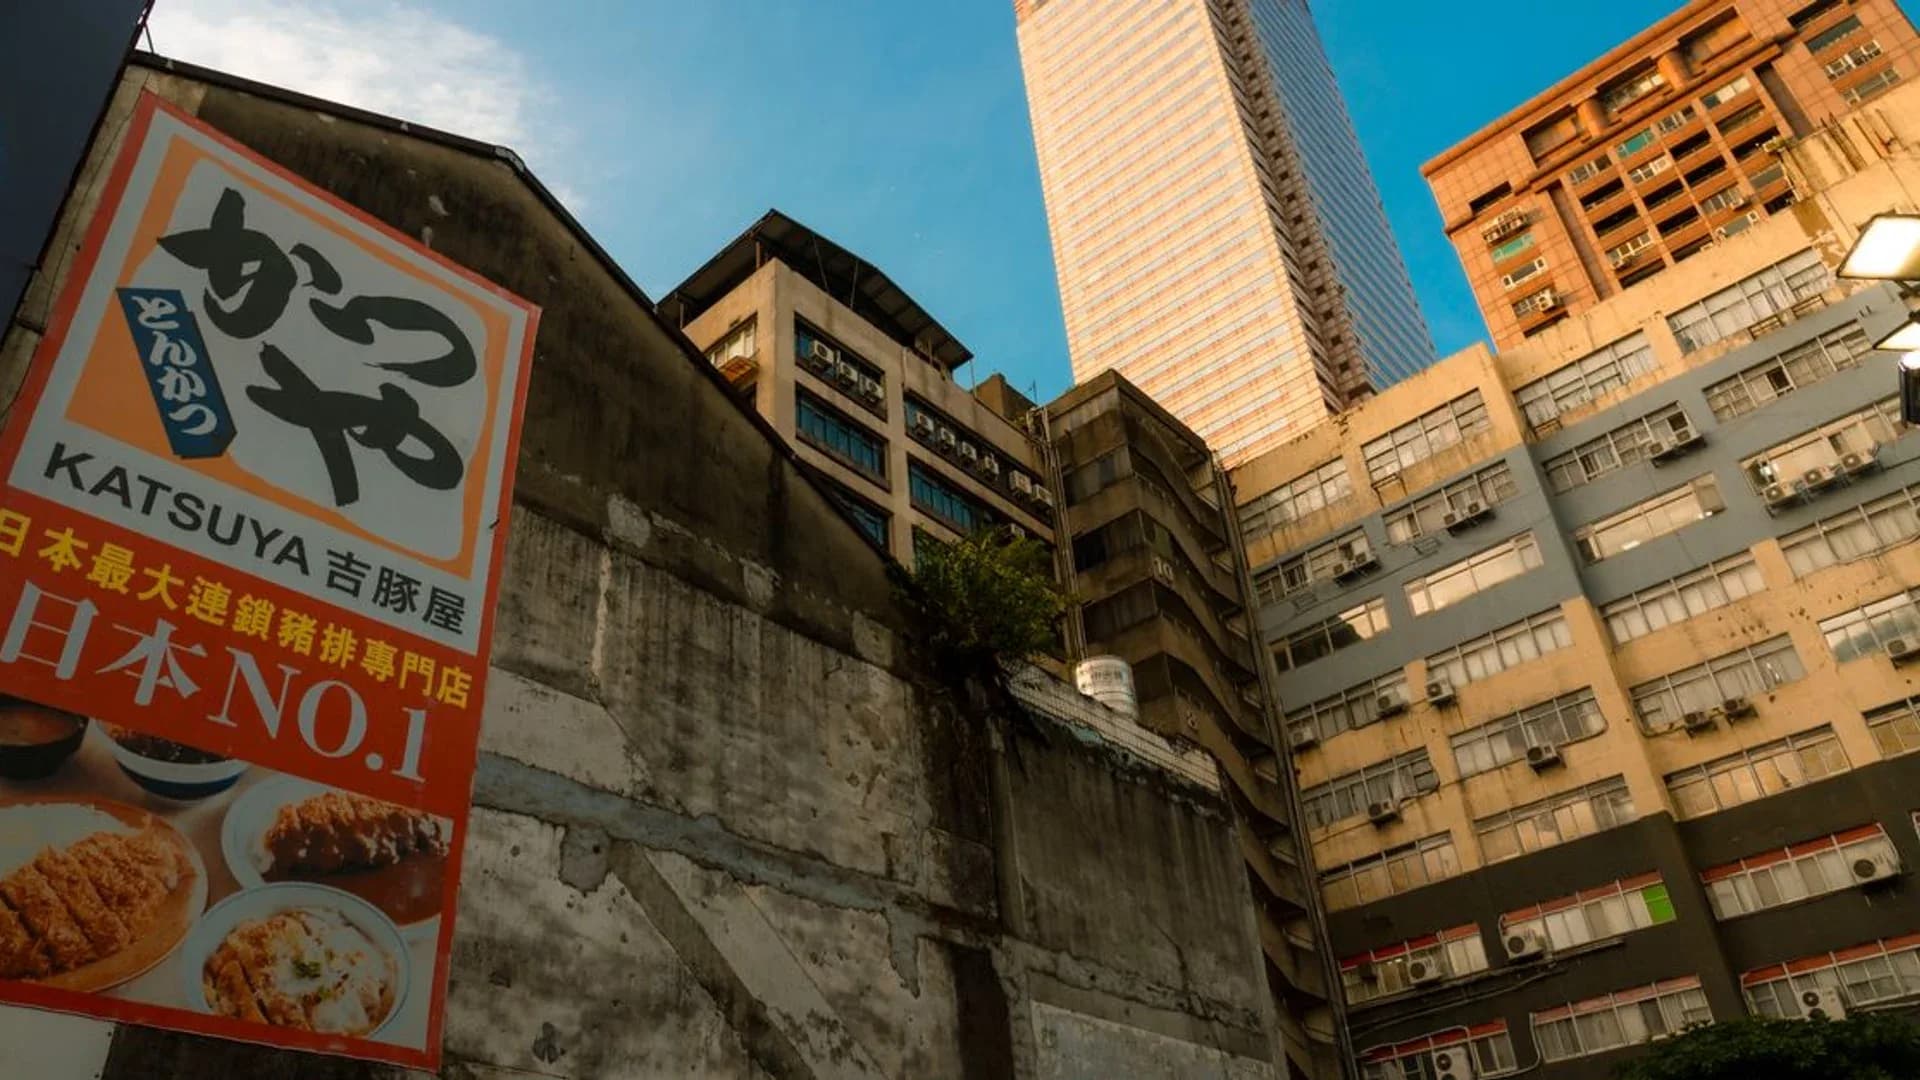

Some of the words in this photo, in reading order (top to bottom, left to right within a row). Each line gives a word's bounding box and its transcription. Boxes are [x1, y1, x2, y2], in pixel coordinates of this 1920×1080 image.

[132, 295, 218, 436] とんかつ
[43, 442, 311, 576] KATSUYA
[325, 548, 466, 635] 吉豚屋
